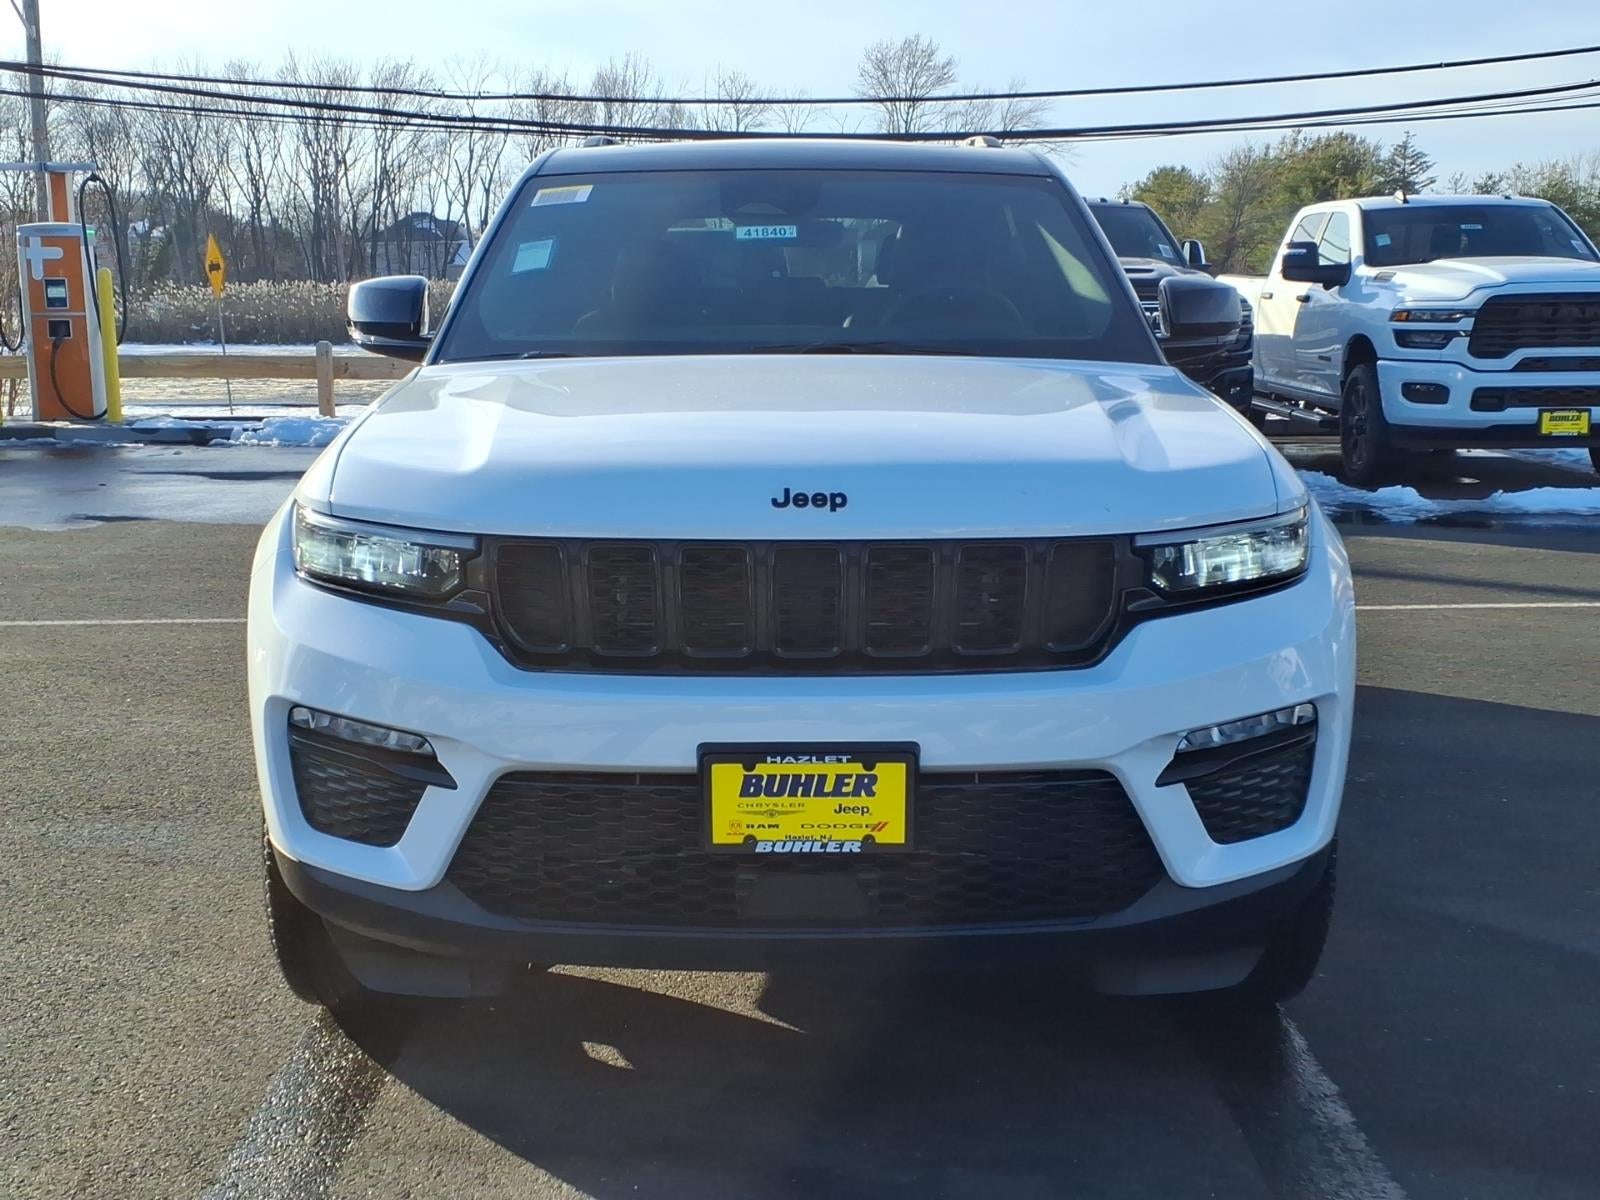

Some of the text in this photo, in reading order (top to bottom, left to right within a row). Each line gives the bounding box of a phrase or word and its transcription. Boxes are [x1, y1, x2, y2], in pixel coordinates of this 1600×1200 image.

[744, 228, 786, 236] 41840
[771, 487, 848, 512] Jeep
[766, 756, 852, 764] HAZLET
[739, 774, 878, 798] BUHLER
[834, 803, 870, 816] Jeep
[755, 840, 862, 852] BUHLER
